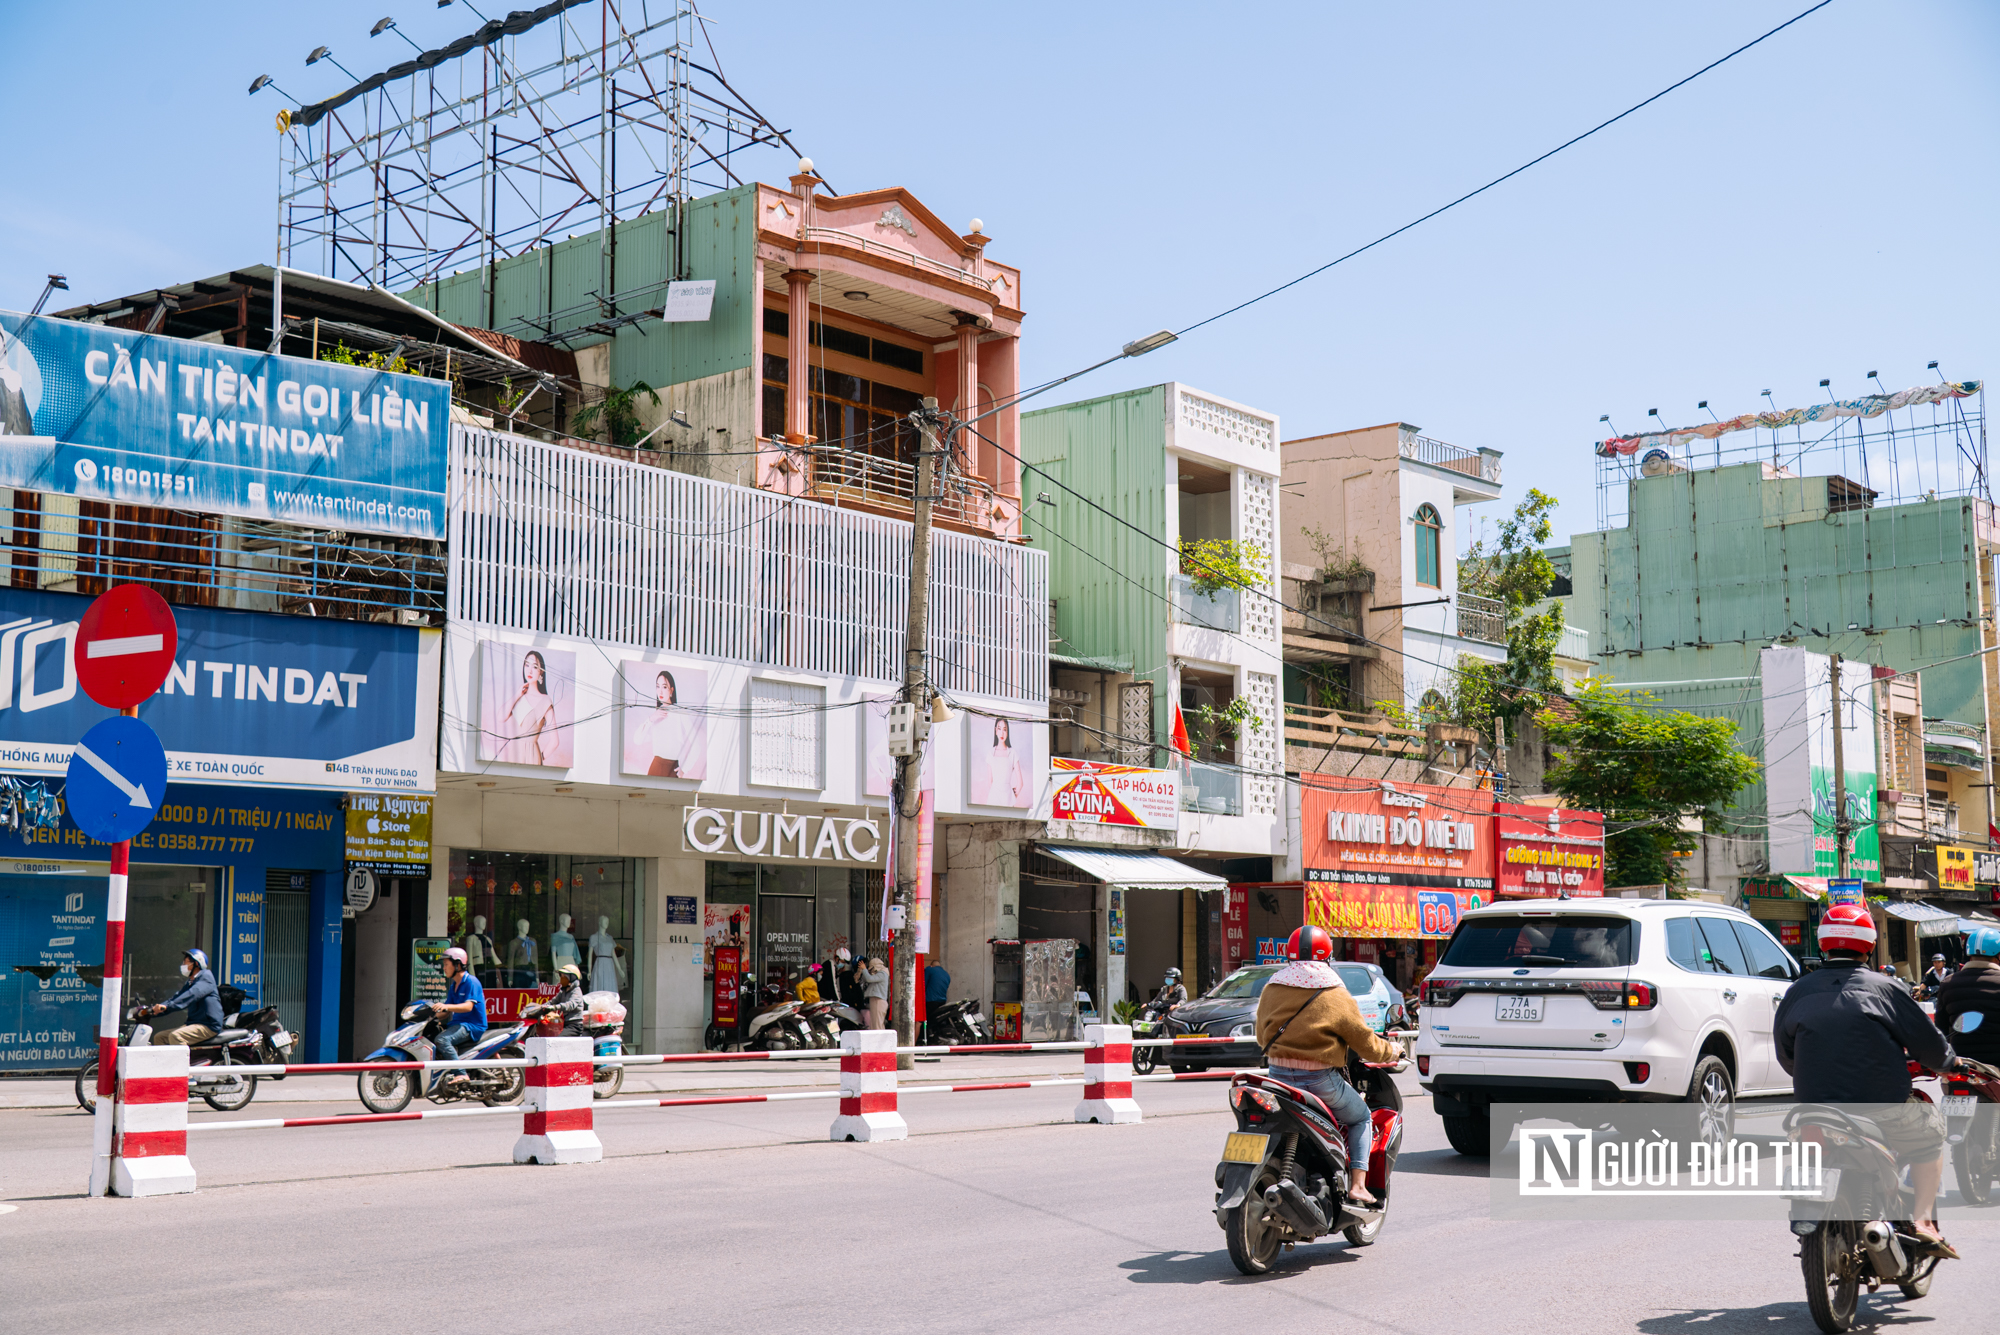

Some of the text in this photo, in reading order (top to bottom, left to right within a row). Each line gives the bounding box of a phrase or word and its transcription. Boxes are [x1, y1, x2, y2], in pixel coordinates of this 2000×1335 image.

[84, 343, 428, 431] CẦN TIỀN GỌI LIỀN
[102, 465, 195, 492] 18001551
[273, 490, 431, 521] www.tantindat.com
[176, 760, 192, 771] XE
[195, 760, 228, 773] TOÀN
[232, 761, 264, 776] QUỐC
[325, 763, 417, 779] 614B TRẦN HƯNG ĐẠO
[361, 777, 417, 787] TP. QUY NHƠN
[1111, 778, 1174, 796] TẠP HÓA 612
[1059, 791, 1115, 815] BIVINA
[229, 806, 271, 831] TRIỆU
[295, 810, 333, 831] NGÀY
[382, 820, 410, 832] Store
[1328, 811, 1385, 844] KINH
[1389, 811, 1422, 847] ĐÔ
[1425, 814, 1474, 854] NỆM
[346, 836, 365, 845] Mua
[685, 808, 881, 862] GUMAC
[346, 848, 429, 861] Phụ Kiện Điện Thoại
[1375, 853, 1390, 863] CHO
[1565, 851, 1593, 869] STORE
[1592, 855, 1601, 869] 2
[23, 864, 61, 872] 18001551
[1525, 866, 1544, 883] BÁN
[1564, 869, 1583, 886] GÓP
[1770, 881, 1784, 897] GIÁ
[235, 891, 263, 905] NHẬN
[52, 915, 96, 924] TANTINDAT
[238, 910, 259, 923] TIỀN
[1230, 906, 1240, 921] LẺ
[238, 933, 258, 943] SAU
[766, 932, 810, 943] OPEN TIME
[1228, 925, 1243, 939] GIÁ
[669, 935, 689, 944] 614 A
[774, 944, 803, 953] Welcome
[1258, 937, 1275, 956] XẢ
[40, 951, 52, 960] Vay
[242, 954, 253, 964] 10
[234, 971, 259, 984] PHÚT
[41, 993, 98, 1003] Giải ngân 5 phút
[1510, 997, 1530, 1008] 77A
[1501, 1008, 1537, 1020] 279.09
[19, 1030, 33, 1043] LÀ
[35, 1029, 50, 1043] CÓ
[52, 1028, 76, 1042] TIỀN
[8, 1046, 66, 1061] NGƯỜI BẢO
[1941, 1105, 1973, 1115] 610.36
